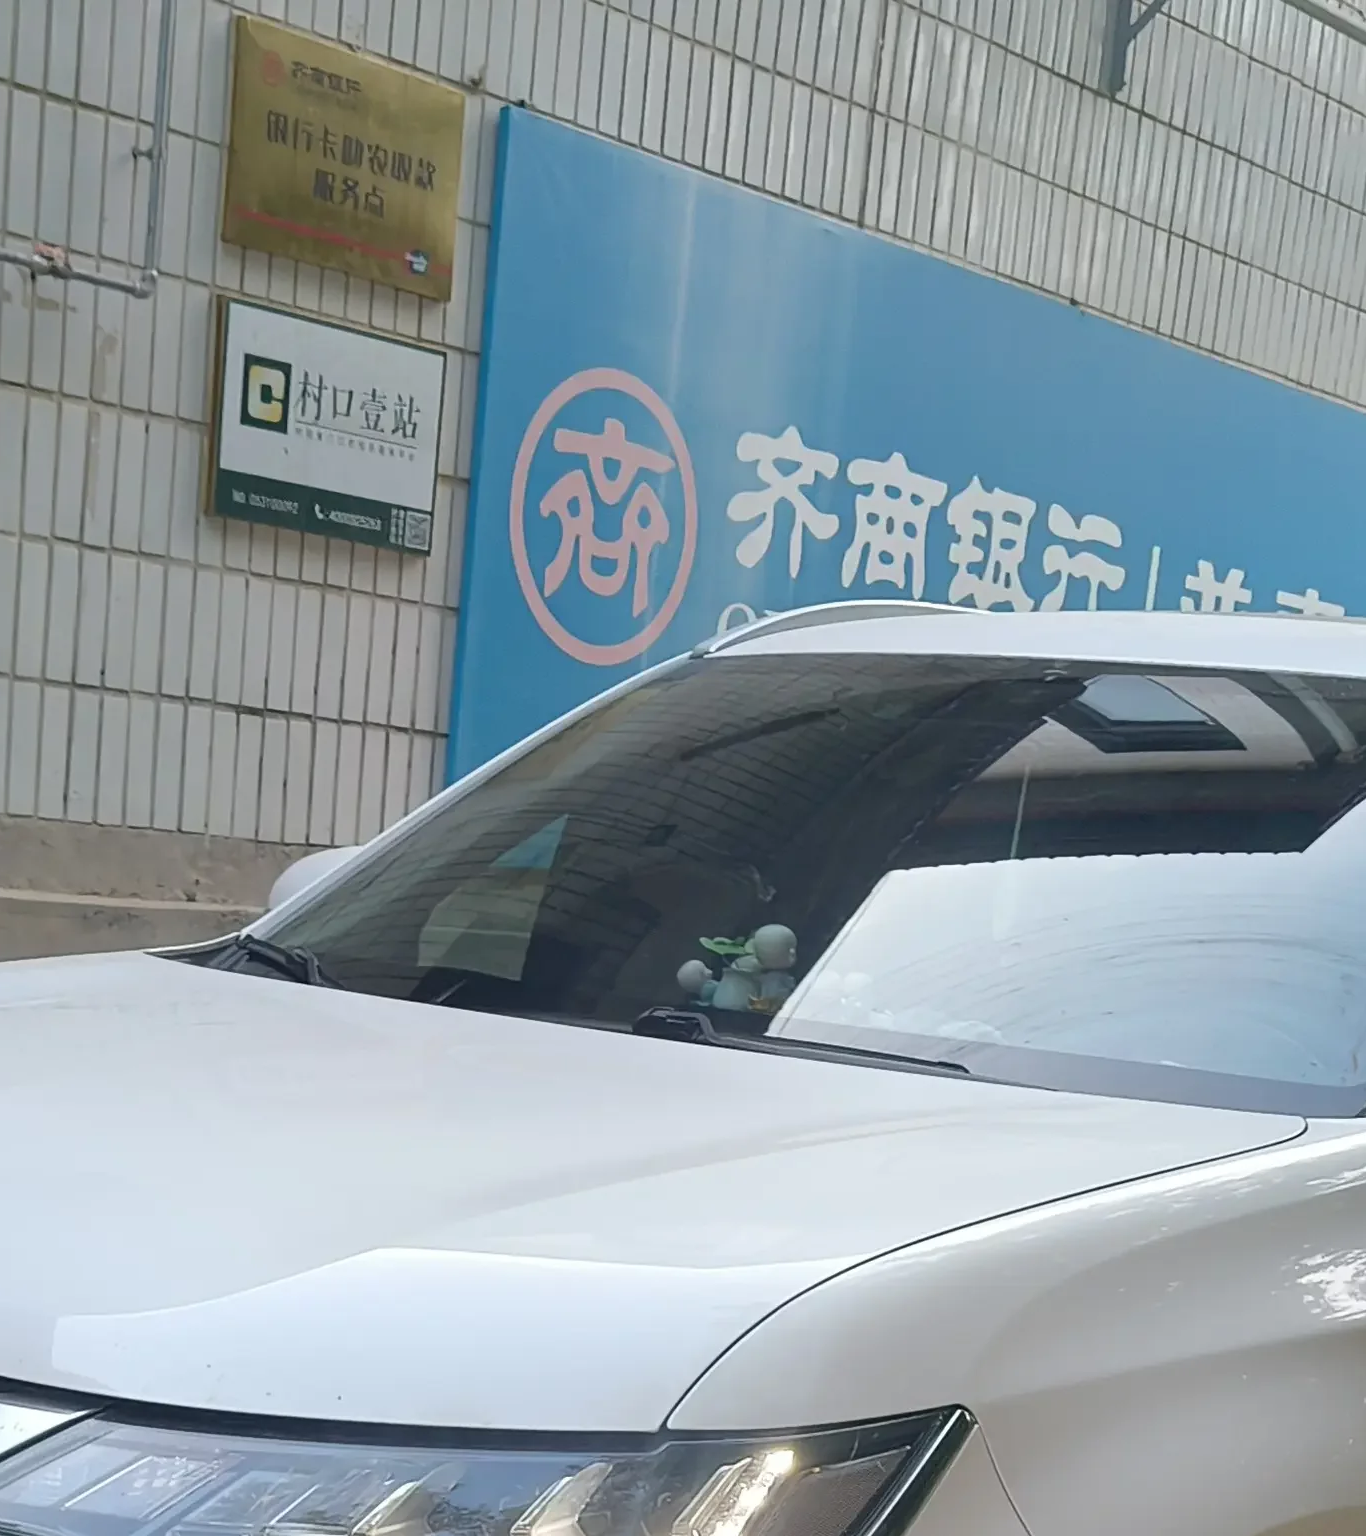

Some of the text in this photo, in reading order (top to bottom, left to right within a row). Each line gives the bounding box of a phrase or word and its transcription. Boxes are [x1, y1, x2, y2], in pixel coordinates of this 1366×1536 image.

[313, 168, 385, 219] 服务点
[293, 368, 421, 440] 村口壹站
[726, 426, 1126, 612] 齐商银行
